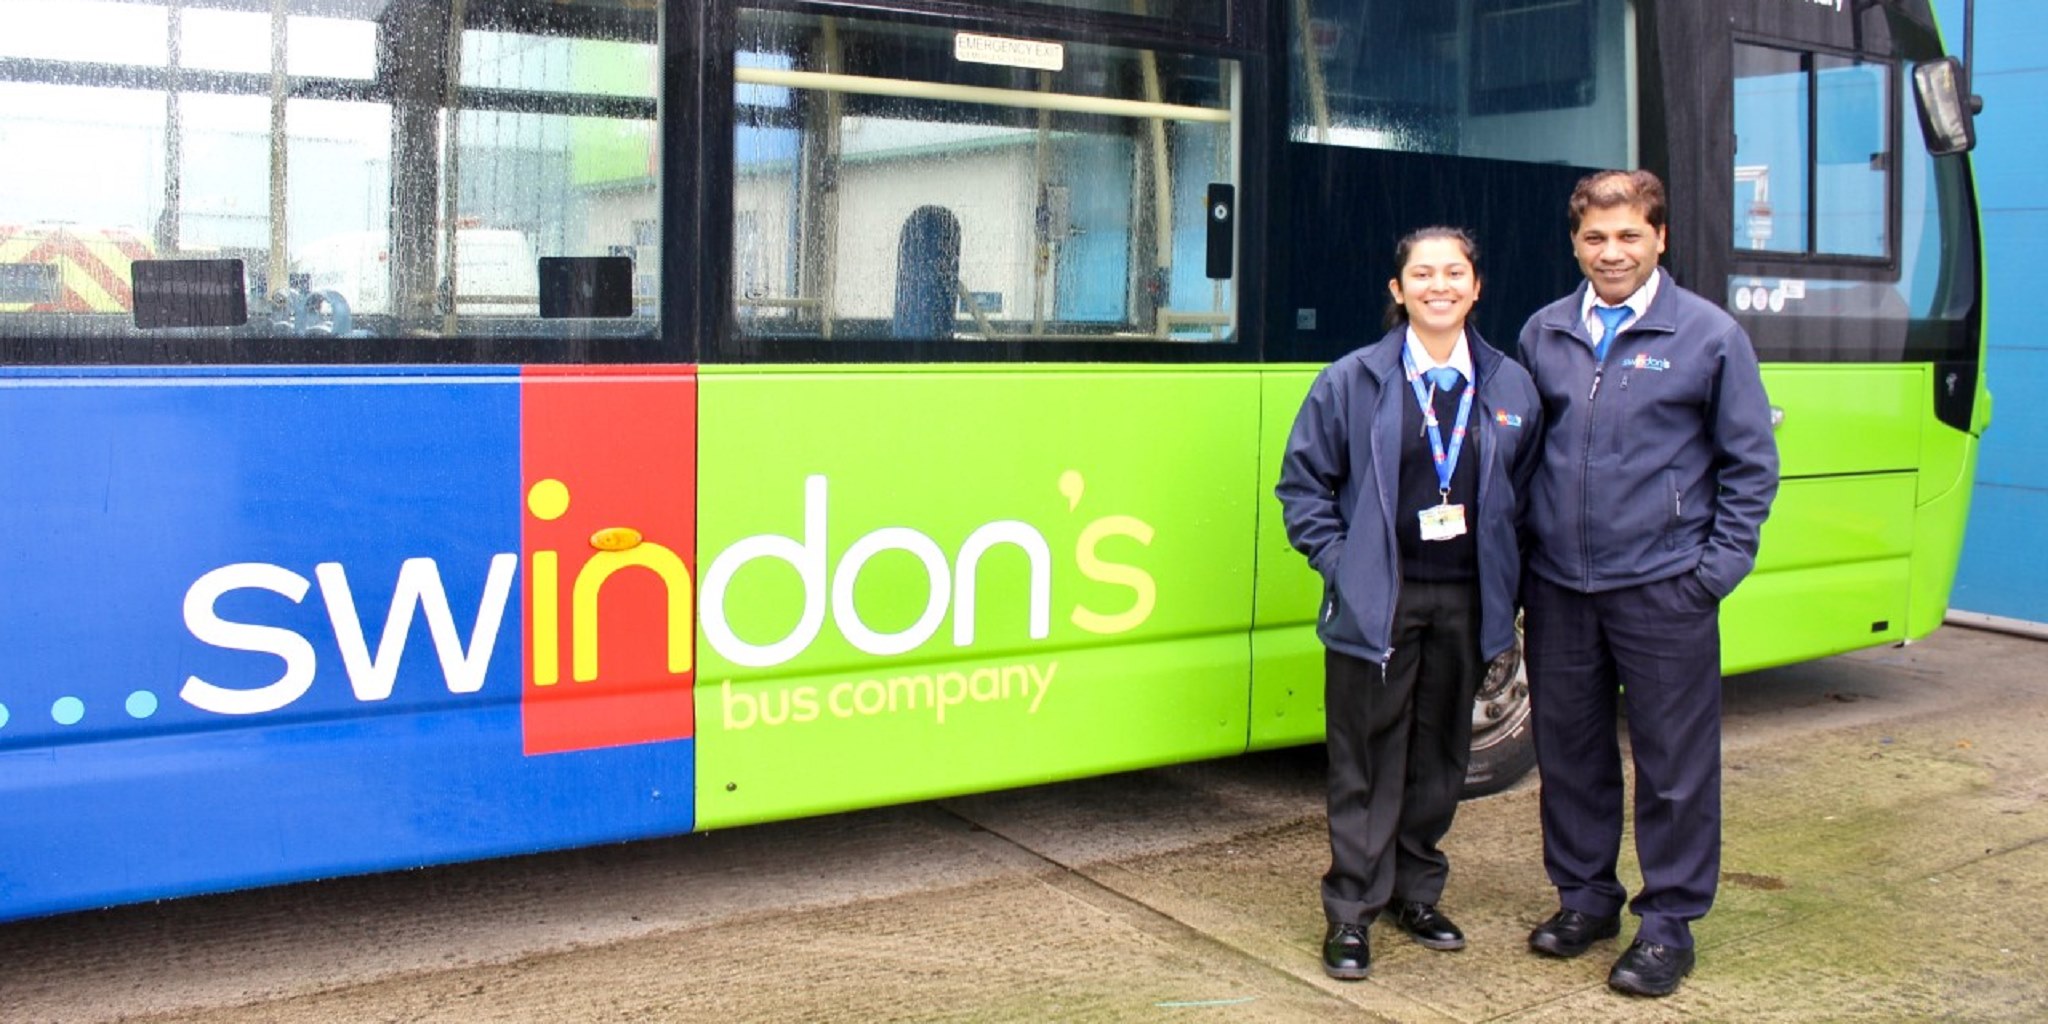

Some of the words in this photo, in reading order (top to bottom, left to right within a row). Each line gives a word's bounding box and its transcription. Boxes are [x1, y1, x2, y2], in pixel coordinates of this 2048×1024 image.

[958, 36, 1033, 55] EMERGENCY
[1035, 45, 1060, 57] EXIT
[179, 469, 1157, 715] swindon's
[722, 679, 820, 732] bus
[828, 661, 1059, 724] company
